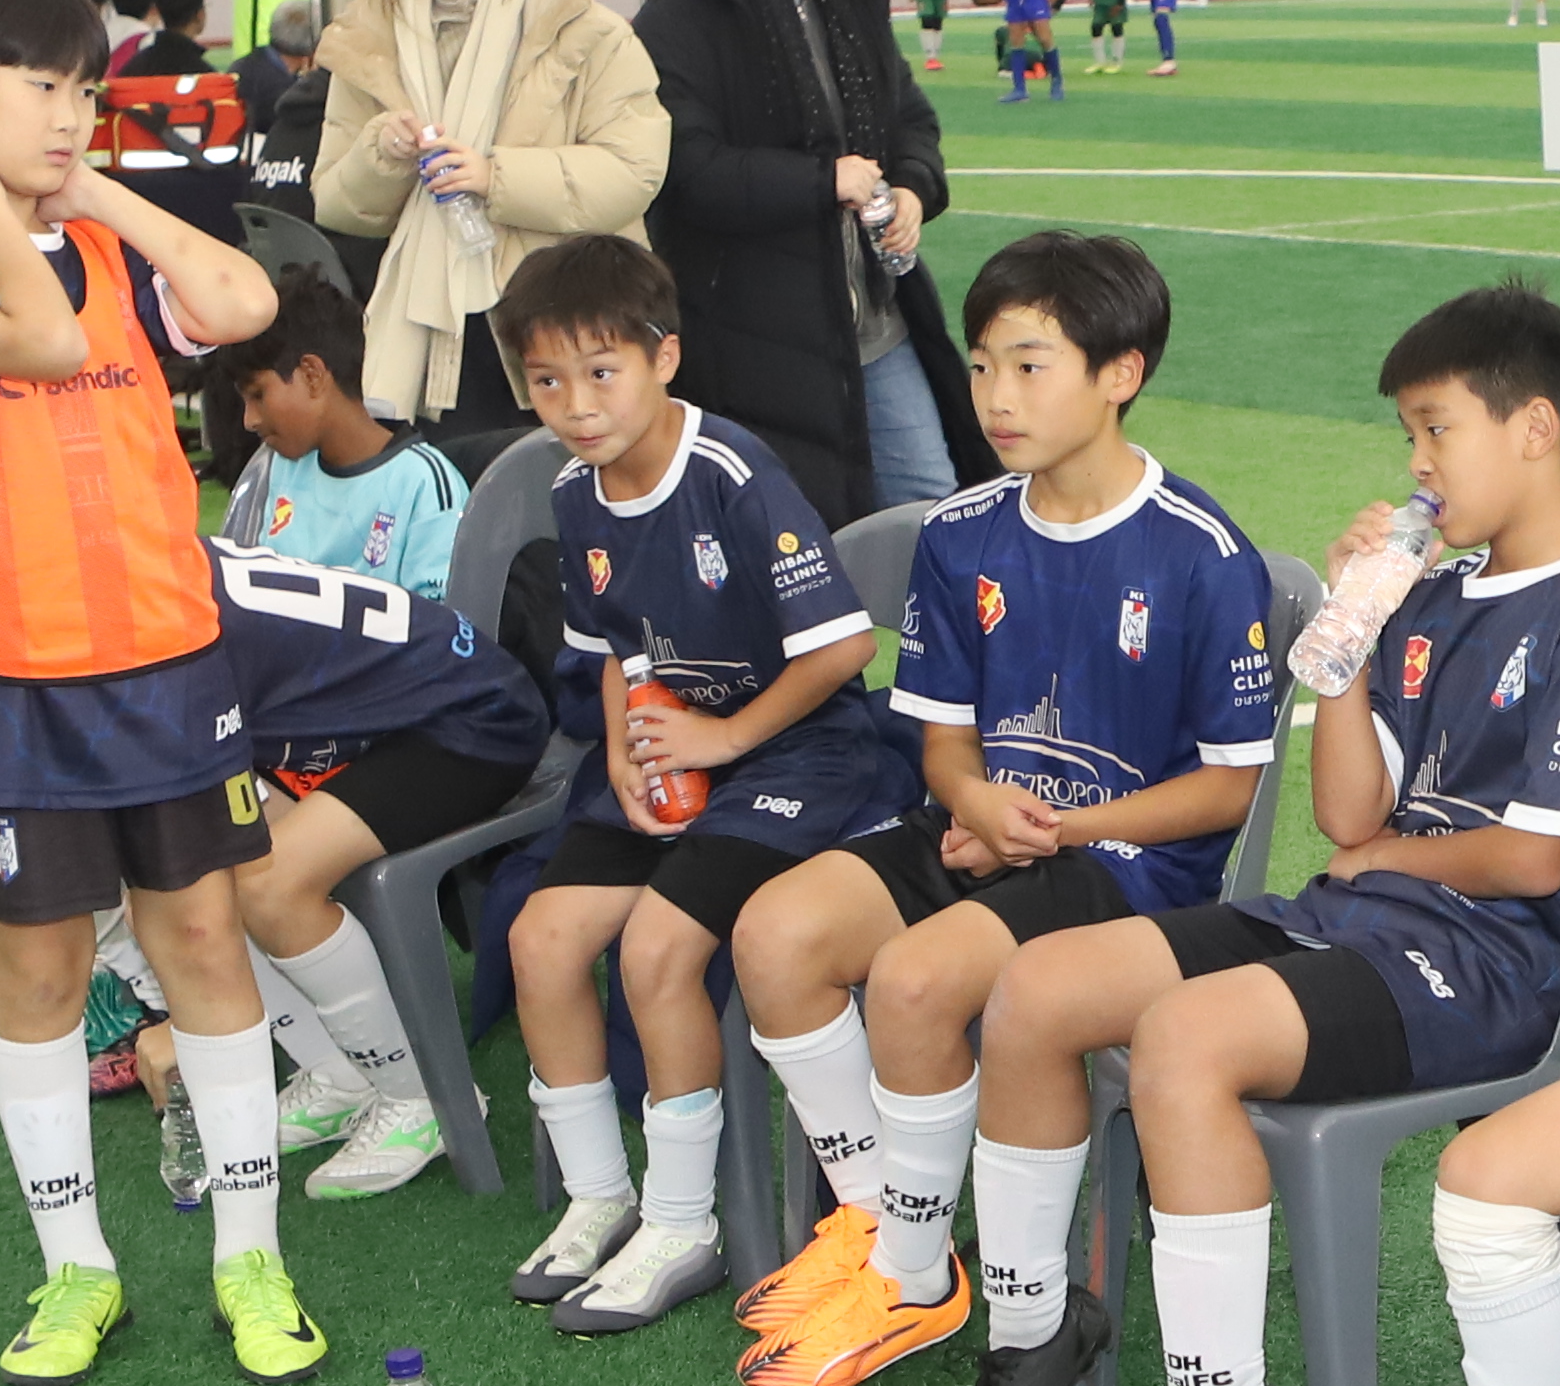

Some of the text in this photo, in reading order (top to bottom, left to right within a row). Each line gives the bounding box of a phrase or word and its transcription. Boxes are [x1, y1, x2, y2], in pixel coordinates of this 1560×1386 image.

[770, 546, 823, 575] HIBARI
[774, 560, 829, 589] CLINIC
[1230, 652, 1270, 673] HIBA
[224, 1155, 272, 1176] KDH
[30, 1172, 81, 1195] KDH
[210, 1171, 278, 1192] GlobalF
